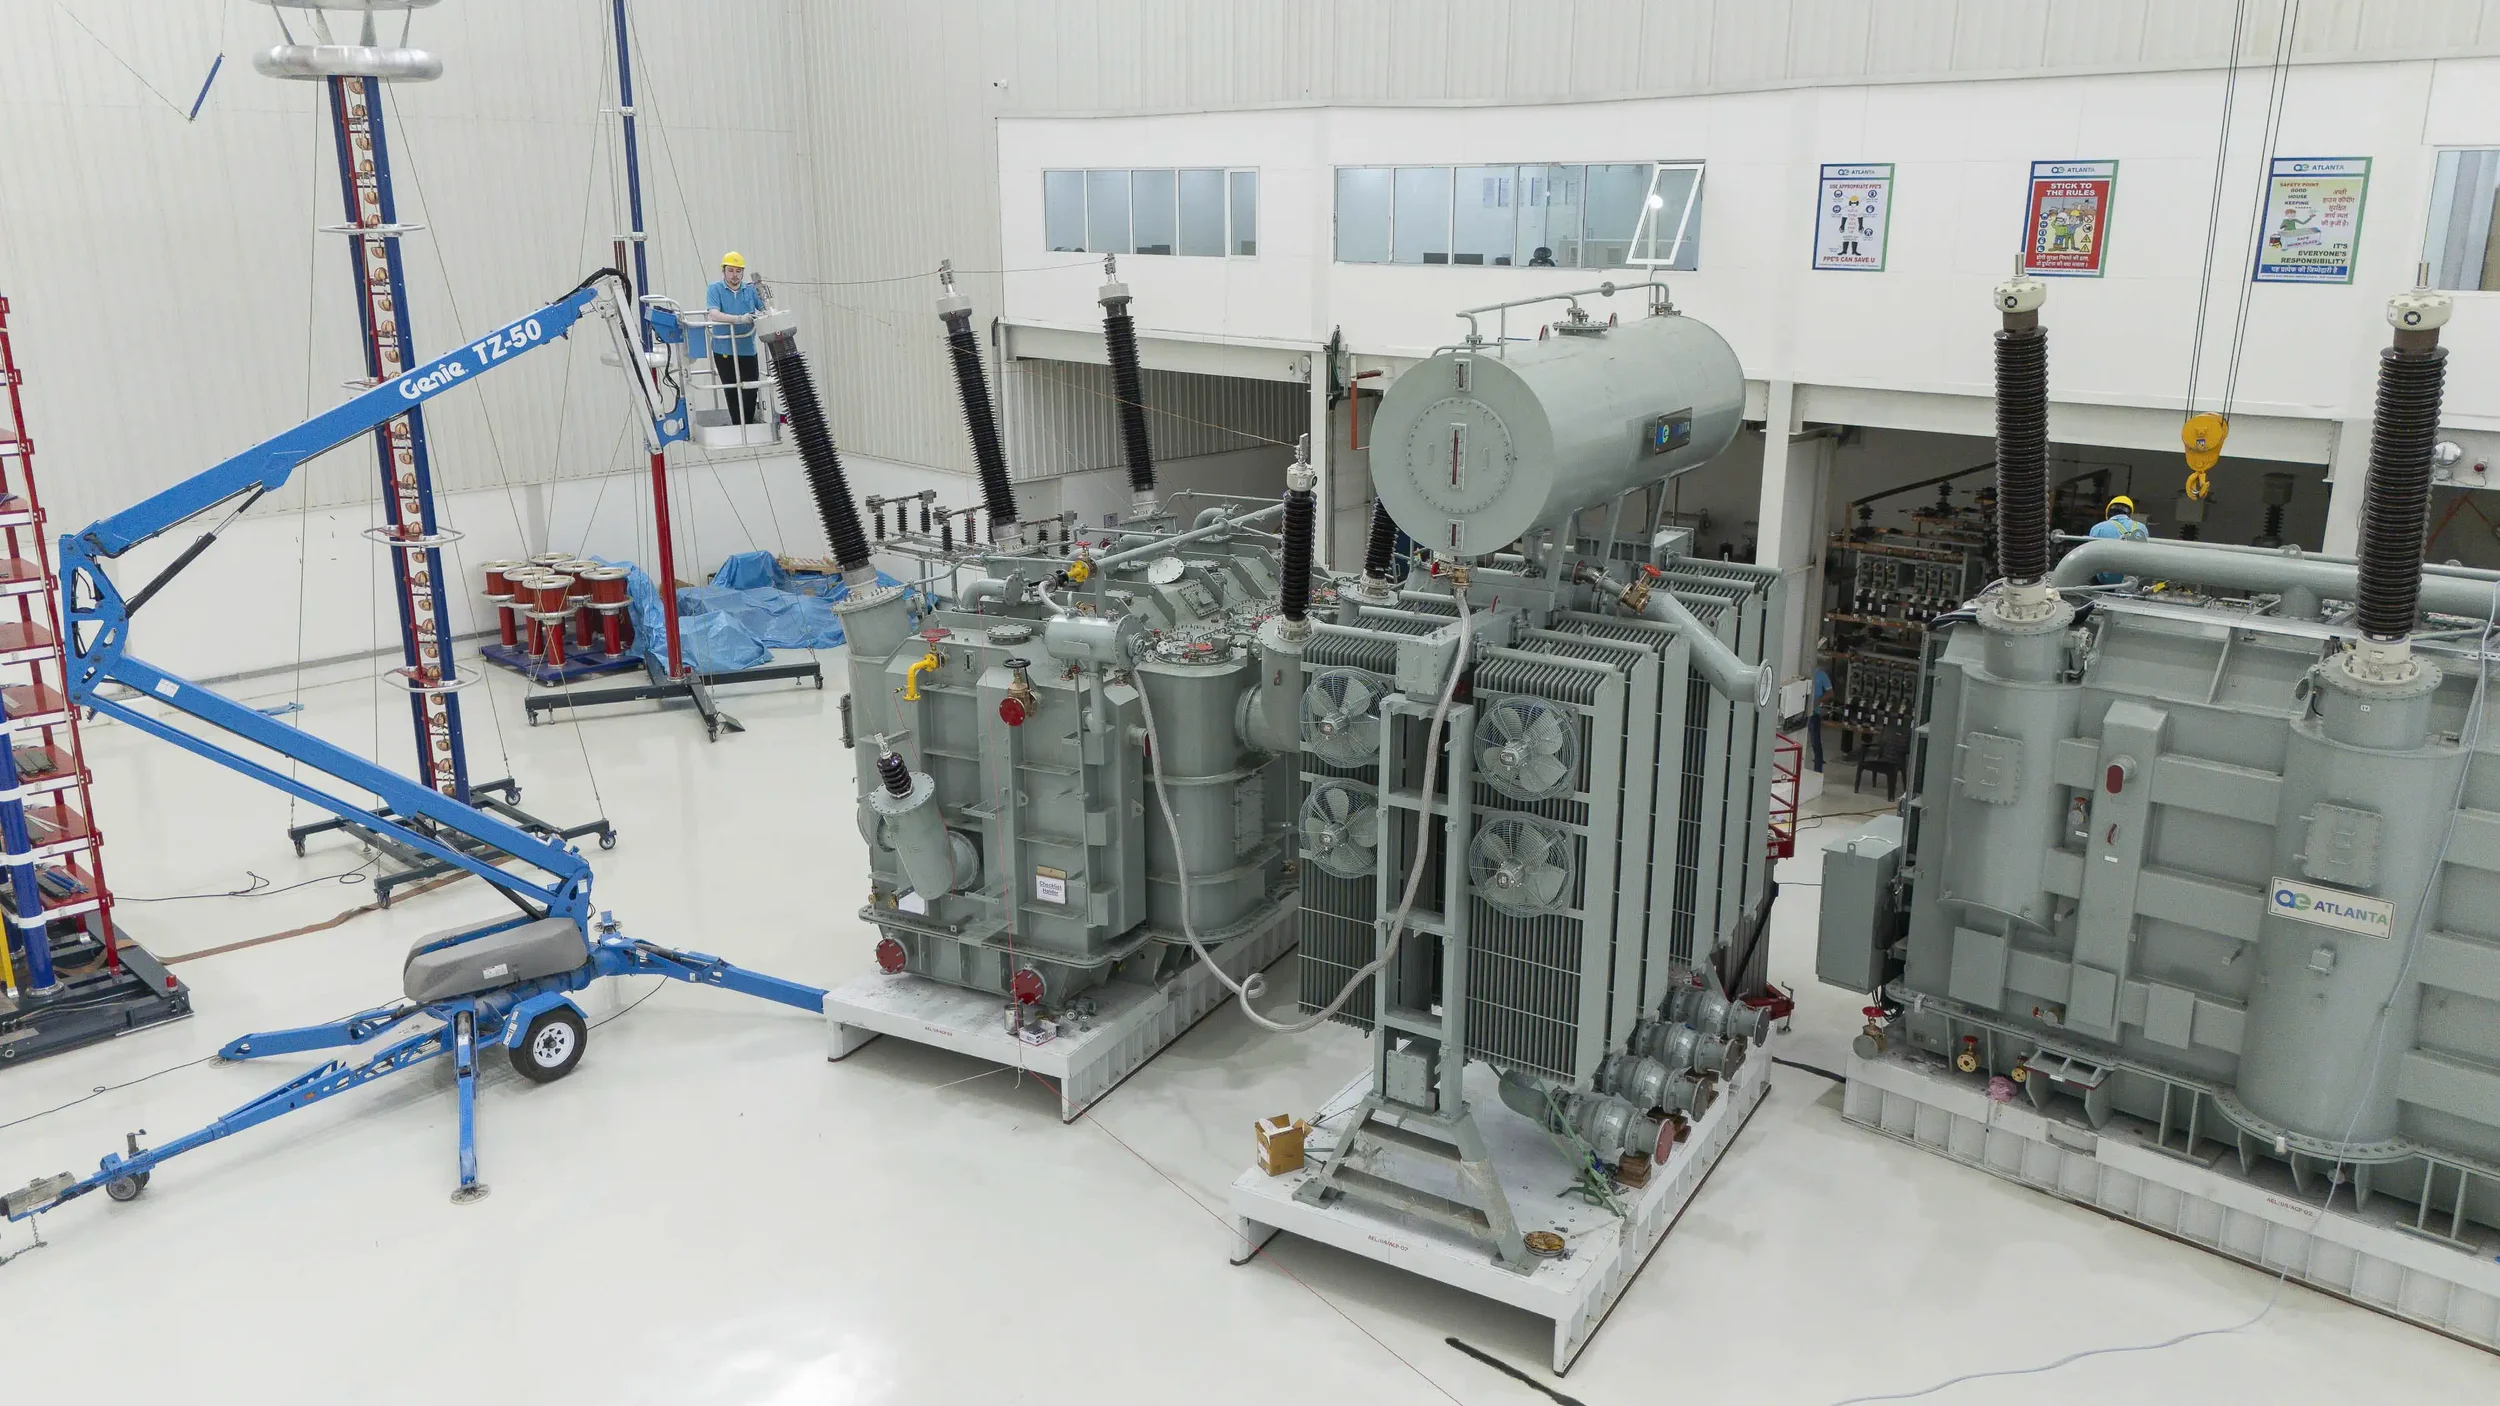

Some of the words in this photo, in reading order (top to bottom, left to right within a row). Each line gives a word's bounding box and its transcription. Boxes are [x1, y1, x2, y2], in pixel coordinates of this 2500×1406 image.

[399, 361, 467, 399] Genie
[472, 319, 542, 365] TZ-50
[1040, 880, 1063, 891] Checklist
[1042, 888, 1060, 896] Holder
[2313, 900, 2389, 926] ATLANTA
